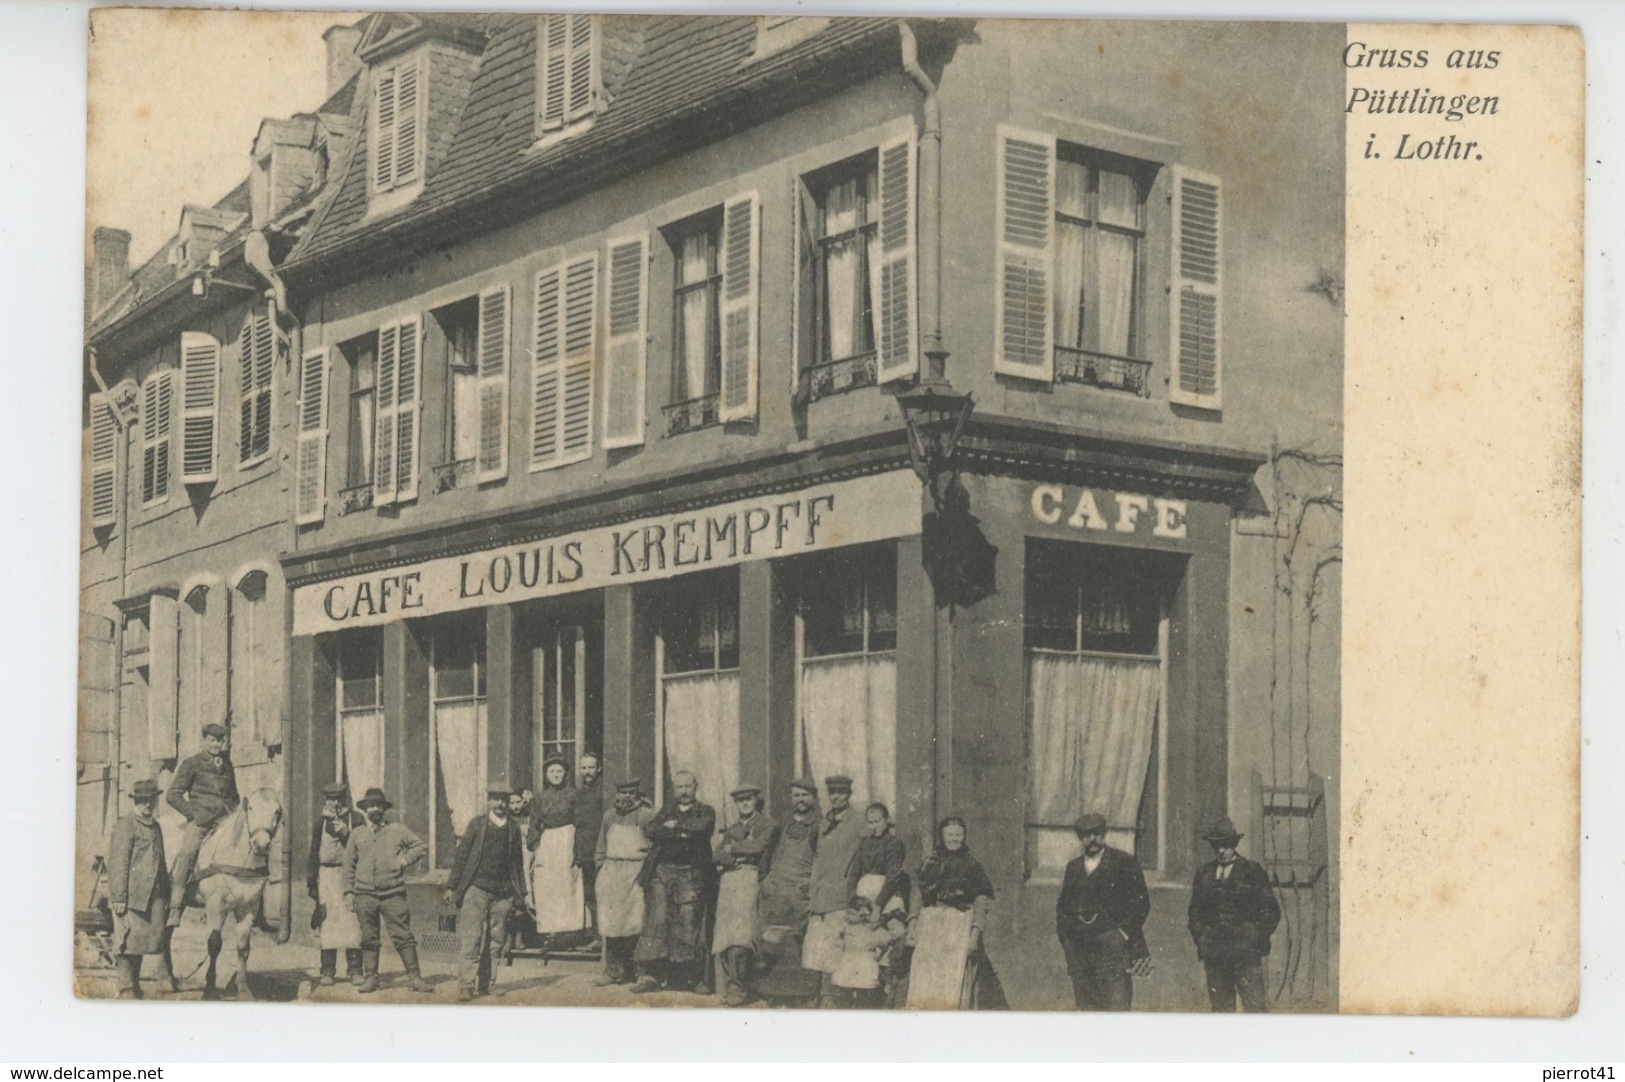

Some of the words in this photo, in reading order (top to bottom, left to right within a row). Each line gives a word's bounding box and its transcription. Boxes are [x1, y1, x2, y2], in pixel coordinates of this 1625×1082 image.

[1030, 484, 1188, 539] CAFE
[323, 571, 425, 621] CAFE
[458, 541, 583, 599] LOUIS
[610, 494, 836, 576] KREMPFF
